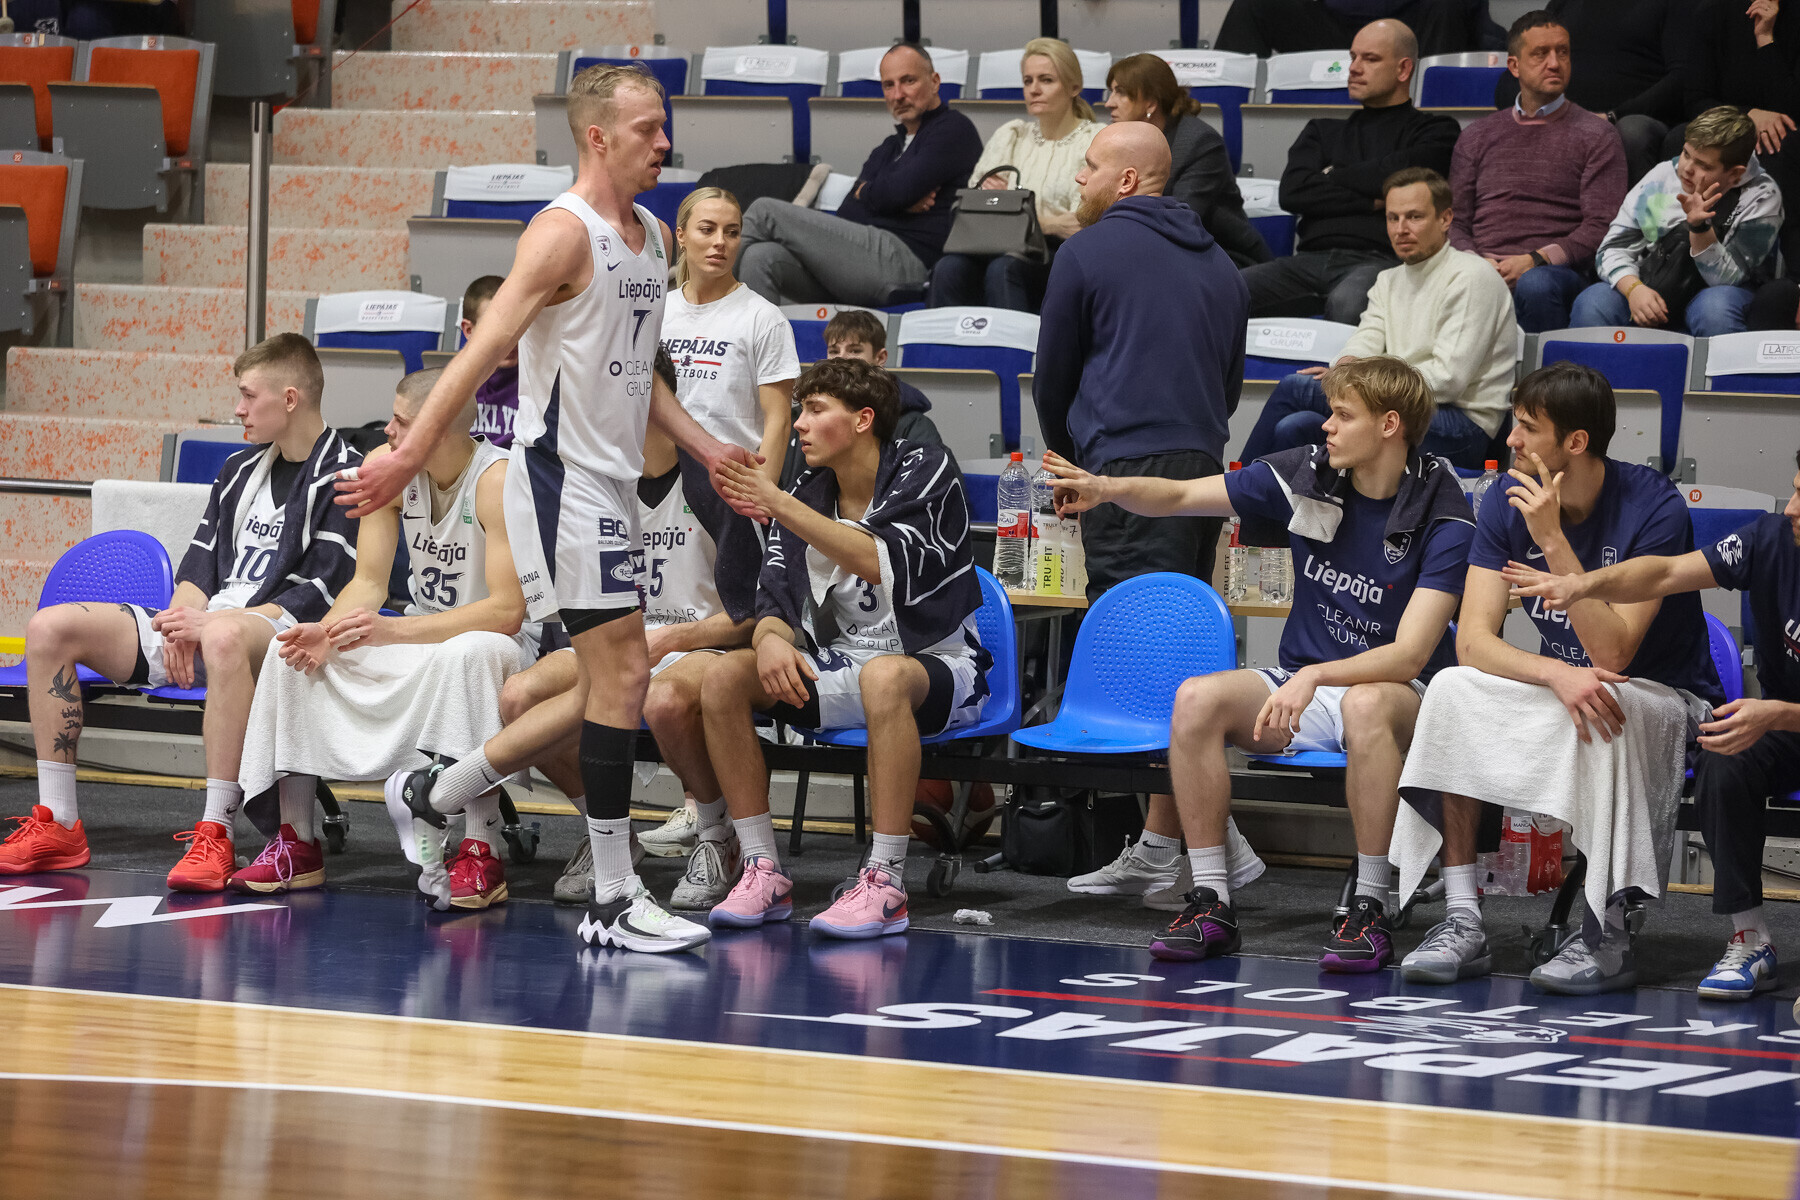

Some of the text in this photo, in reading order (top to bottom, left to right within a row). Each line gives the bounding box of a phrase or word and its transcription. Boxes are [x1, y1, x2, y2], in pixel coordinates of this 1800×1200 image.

[618, 277, 661, 303] Liepāja
[632, 309, 652, 352] 7
[626, 381, 652, 397] GRUP
[675, 368, 718, 381] ETBOLS
[641, 526, 686, 551] epāja
[236, 545, 278, 581] 10
[1043, 546, 1053, 588] TRU FIT
[1303, 554, 1384, 605] Liepāja
[420, 566, 465, 608] 35
[856, 576, 880, 613] 3
[1317, 603, 1382, 636] CLEANR
[1324, 621, 1370, 649] RUPA
[724, 1002, 1800, 1106] IEPĀJAS
